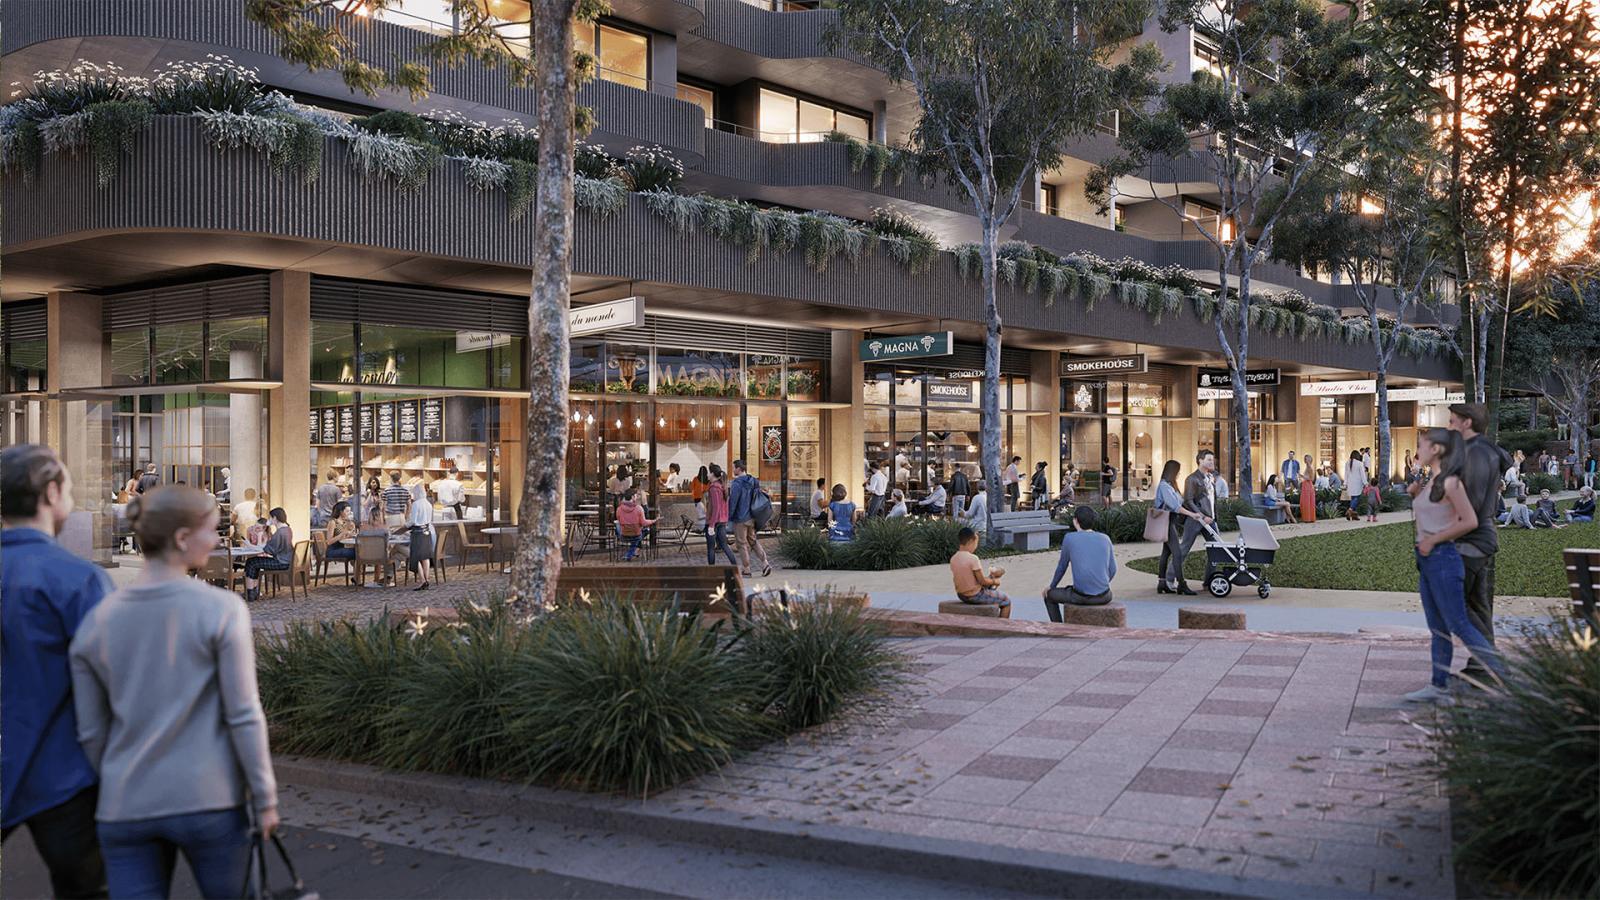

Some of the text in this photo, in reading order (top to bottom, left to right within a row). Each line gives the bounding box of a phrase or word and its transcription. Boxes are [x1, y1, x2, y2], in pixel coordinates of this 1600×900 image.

[571, 315, 583, 325] du
[884, 342, 919, 354] MAGNA
[656, 364, 741, 391] MAGNA
